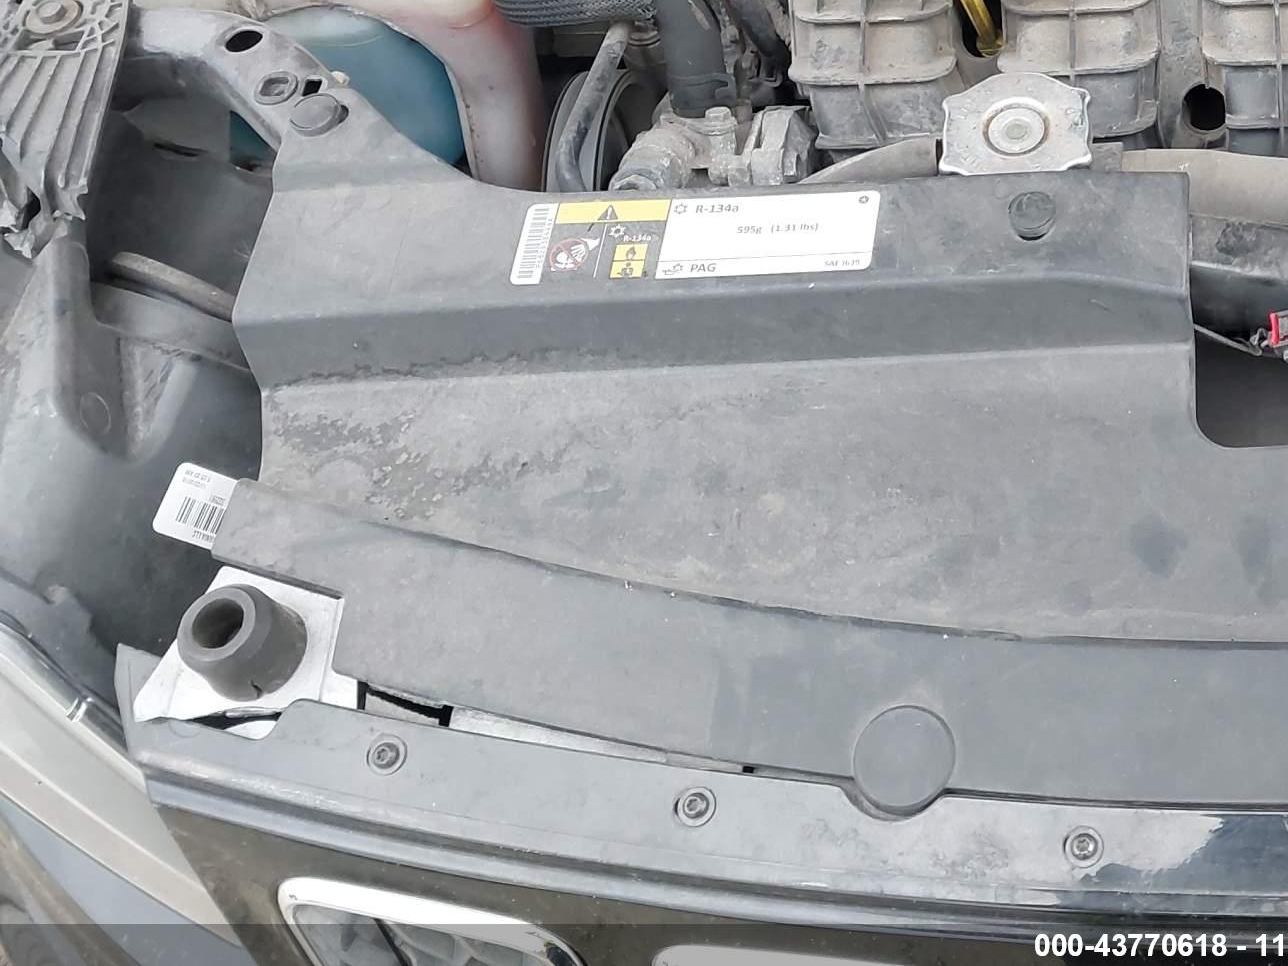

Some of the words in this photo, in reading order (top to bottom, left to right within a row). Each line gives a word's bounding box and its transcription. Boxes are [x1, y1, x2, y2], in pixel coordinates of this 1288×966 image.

[695, 203, 740, 214] R-134a
[736, 225, 763, 235] 595g
[770, 224, 797, 234] (1.31
[799, 222, 820, 233] lbs)
[689, 262, 717, 274] PAG
